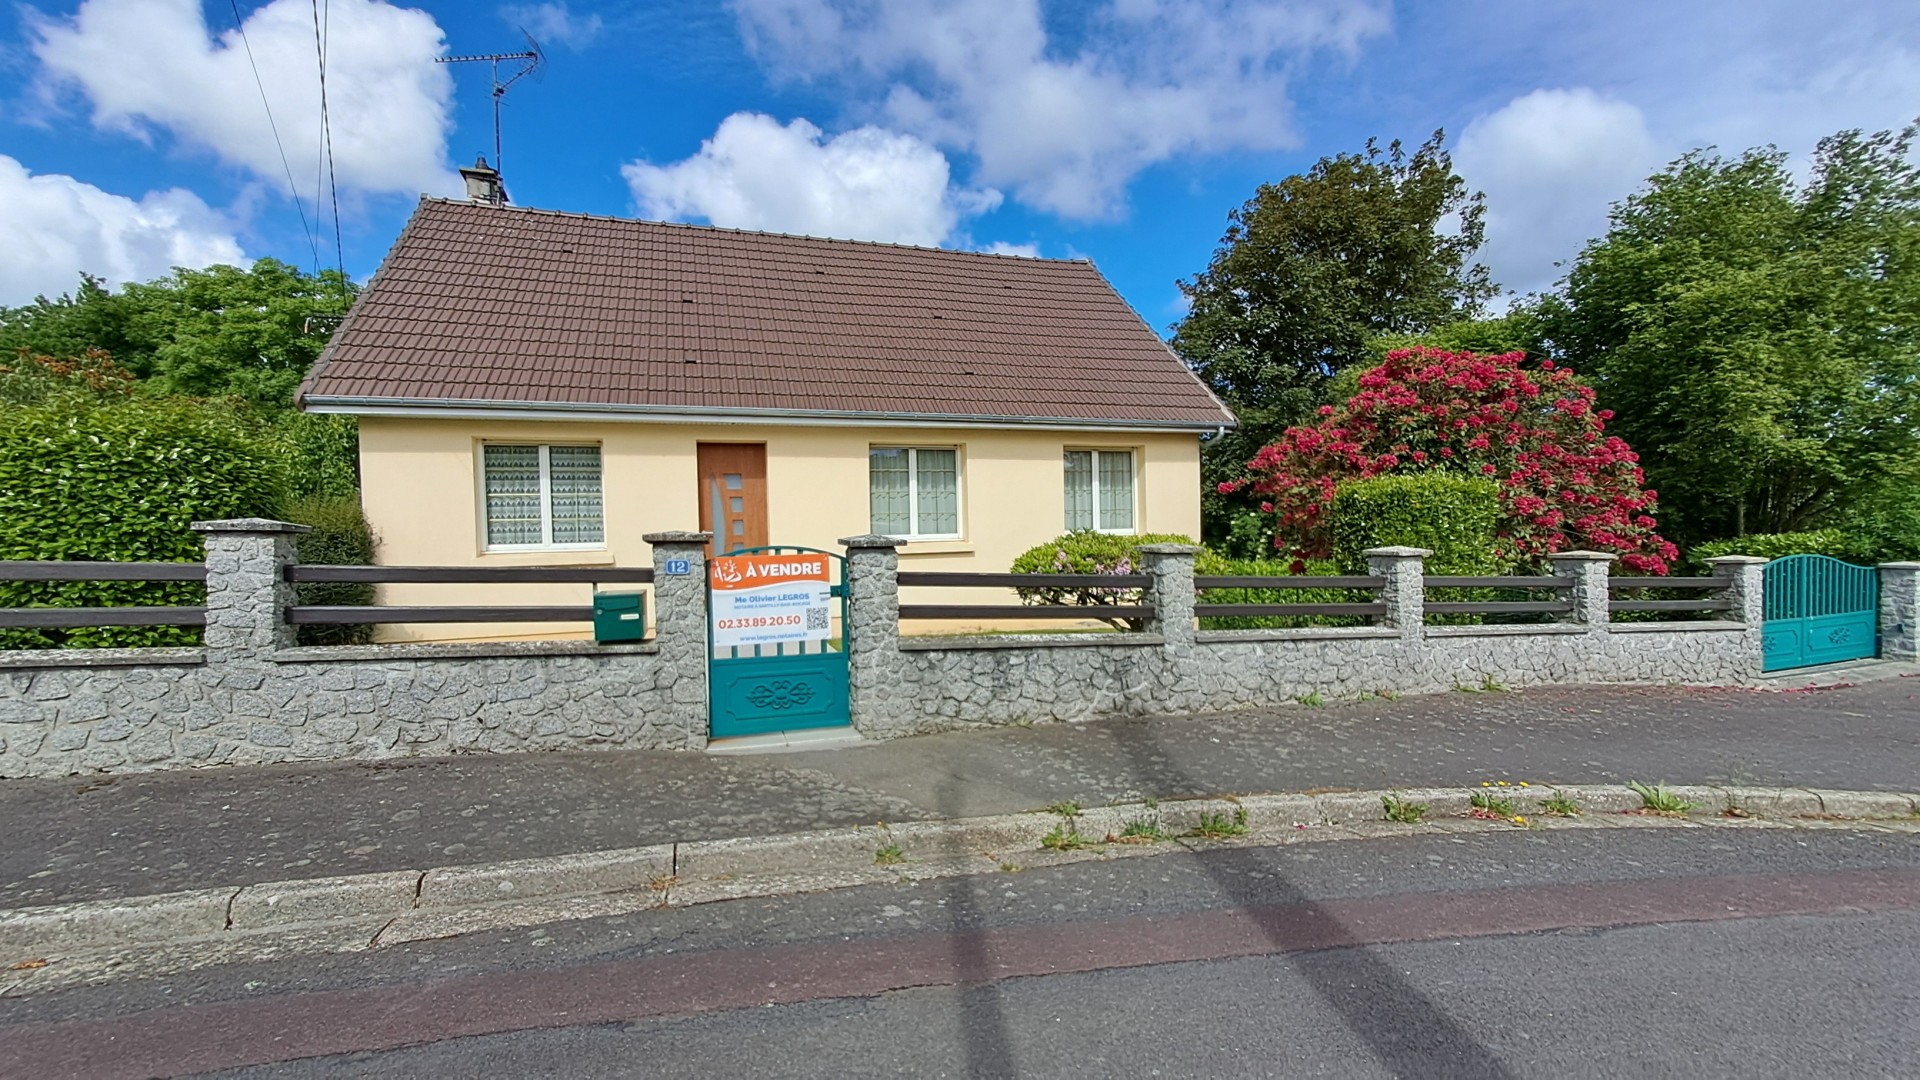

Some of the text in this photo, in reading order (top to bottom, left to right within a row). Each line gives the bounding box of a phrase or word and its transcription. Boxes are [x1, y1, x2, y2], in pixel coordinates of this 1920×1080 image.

[671, 561, 686, 573] 12
[745, 561, 822, 578] À VENDRE
[749, 595, 777, 603] Olivier
[777, 593, 810, 601] LEGROS
[718, 615, 801, 630] 02.33.89.20.50
